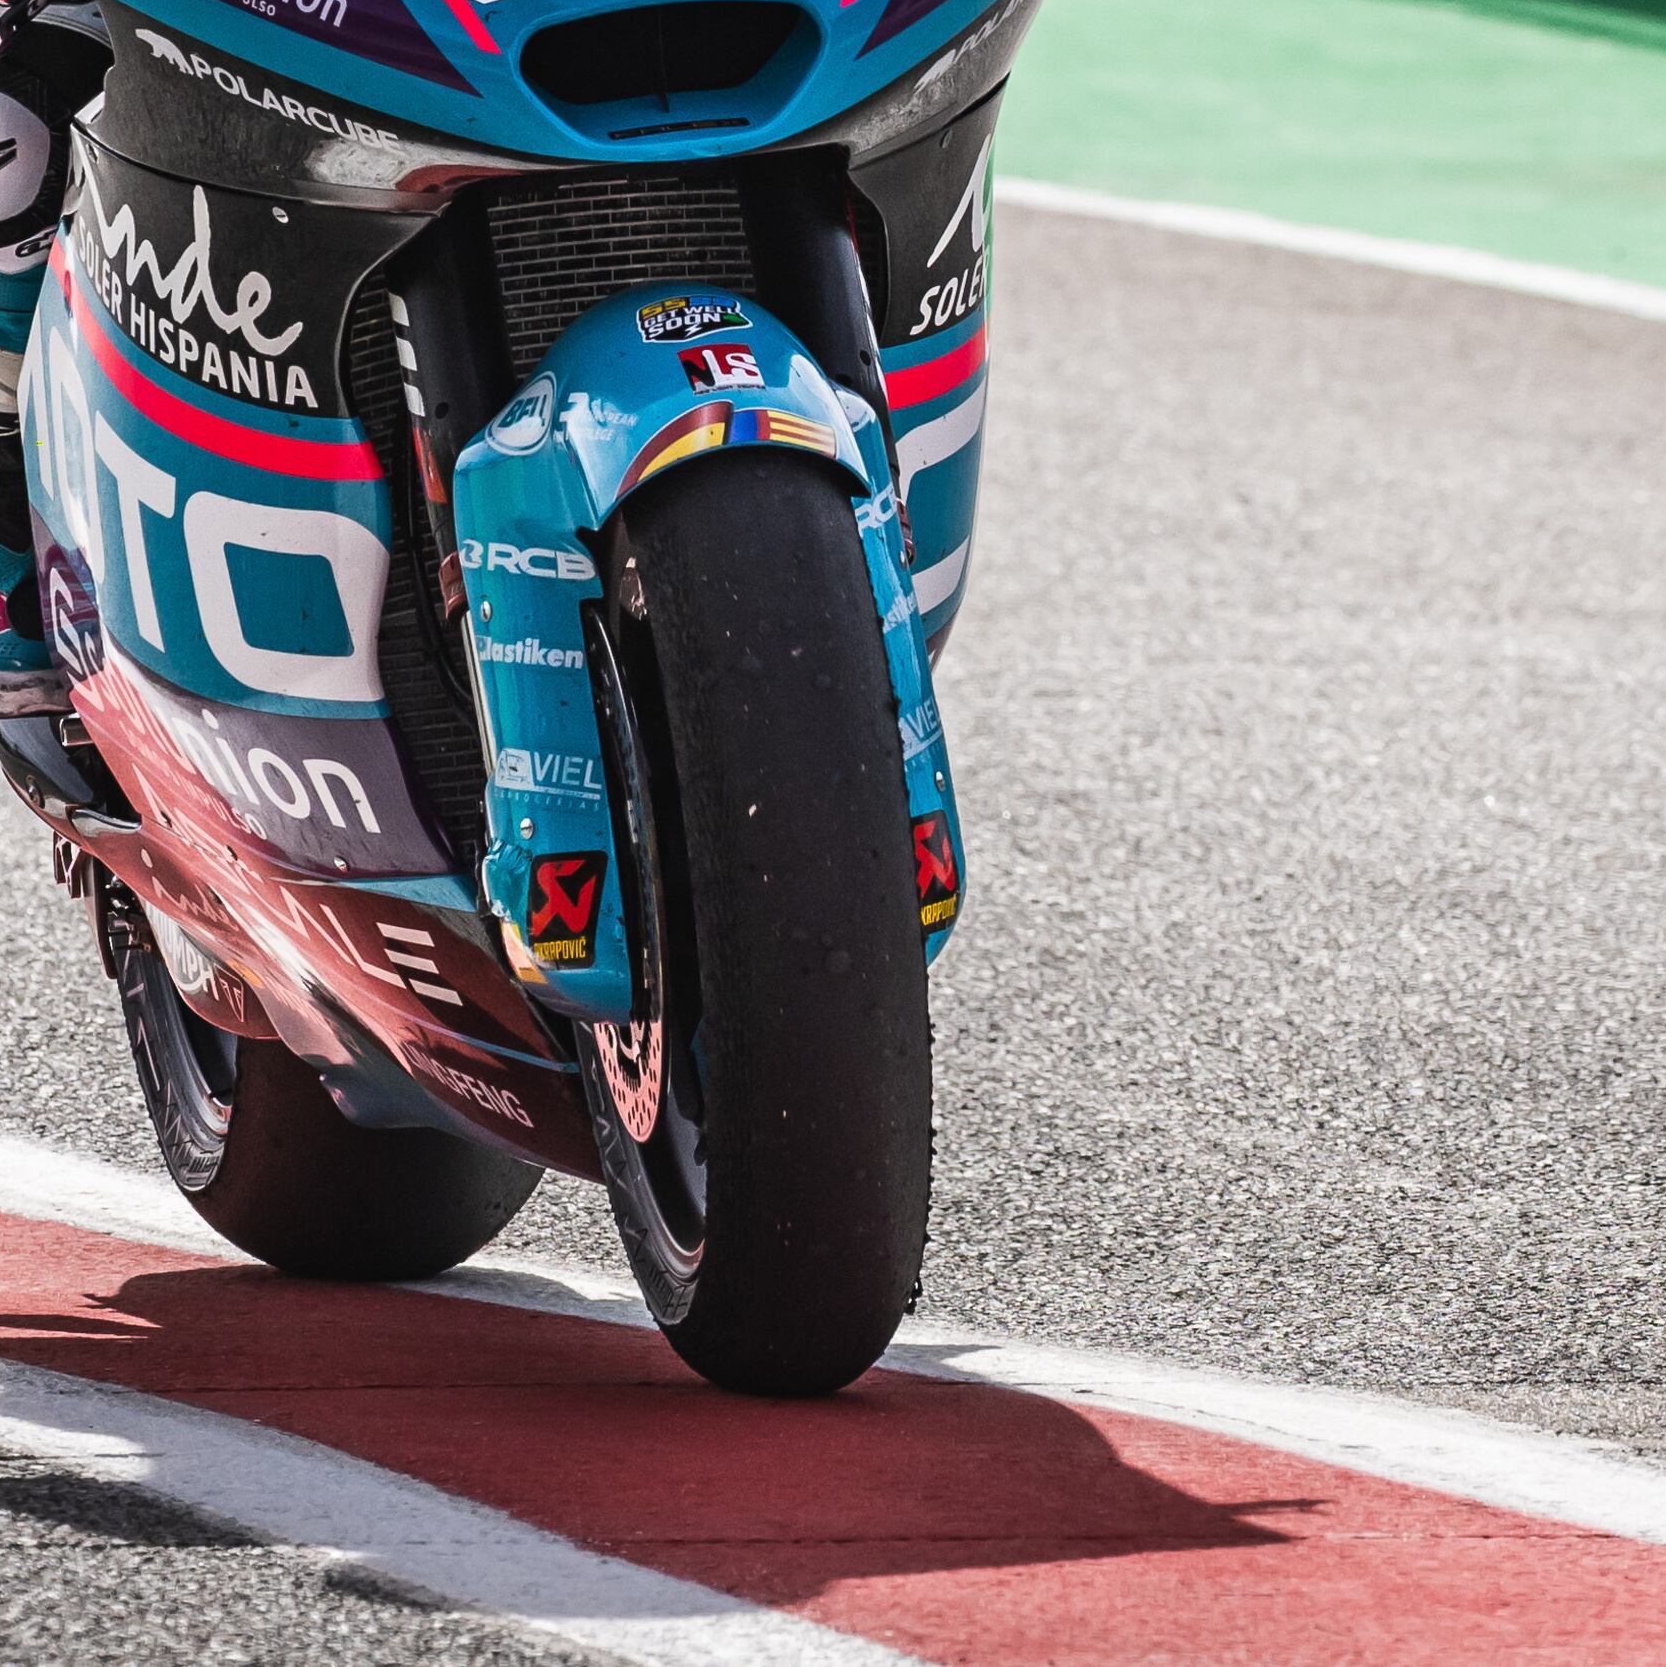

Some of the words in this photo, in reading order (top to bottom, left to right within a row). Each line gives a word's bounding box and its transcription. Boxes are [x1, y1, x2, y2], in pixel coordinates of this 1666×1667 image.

[191, 52, 401, 152] POLARCUBE
[644, 309, 682, 329] GET
[683, 305, 737, 315] WELL
[648, 312, 722, 338] SOON
[130, 294, 319, 409] HISPANIA
[485, 546, 596, 582] RCB
[533, 750, 603, 790] VIEL
